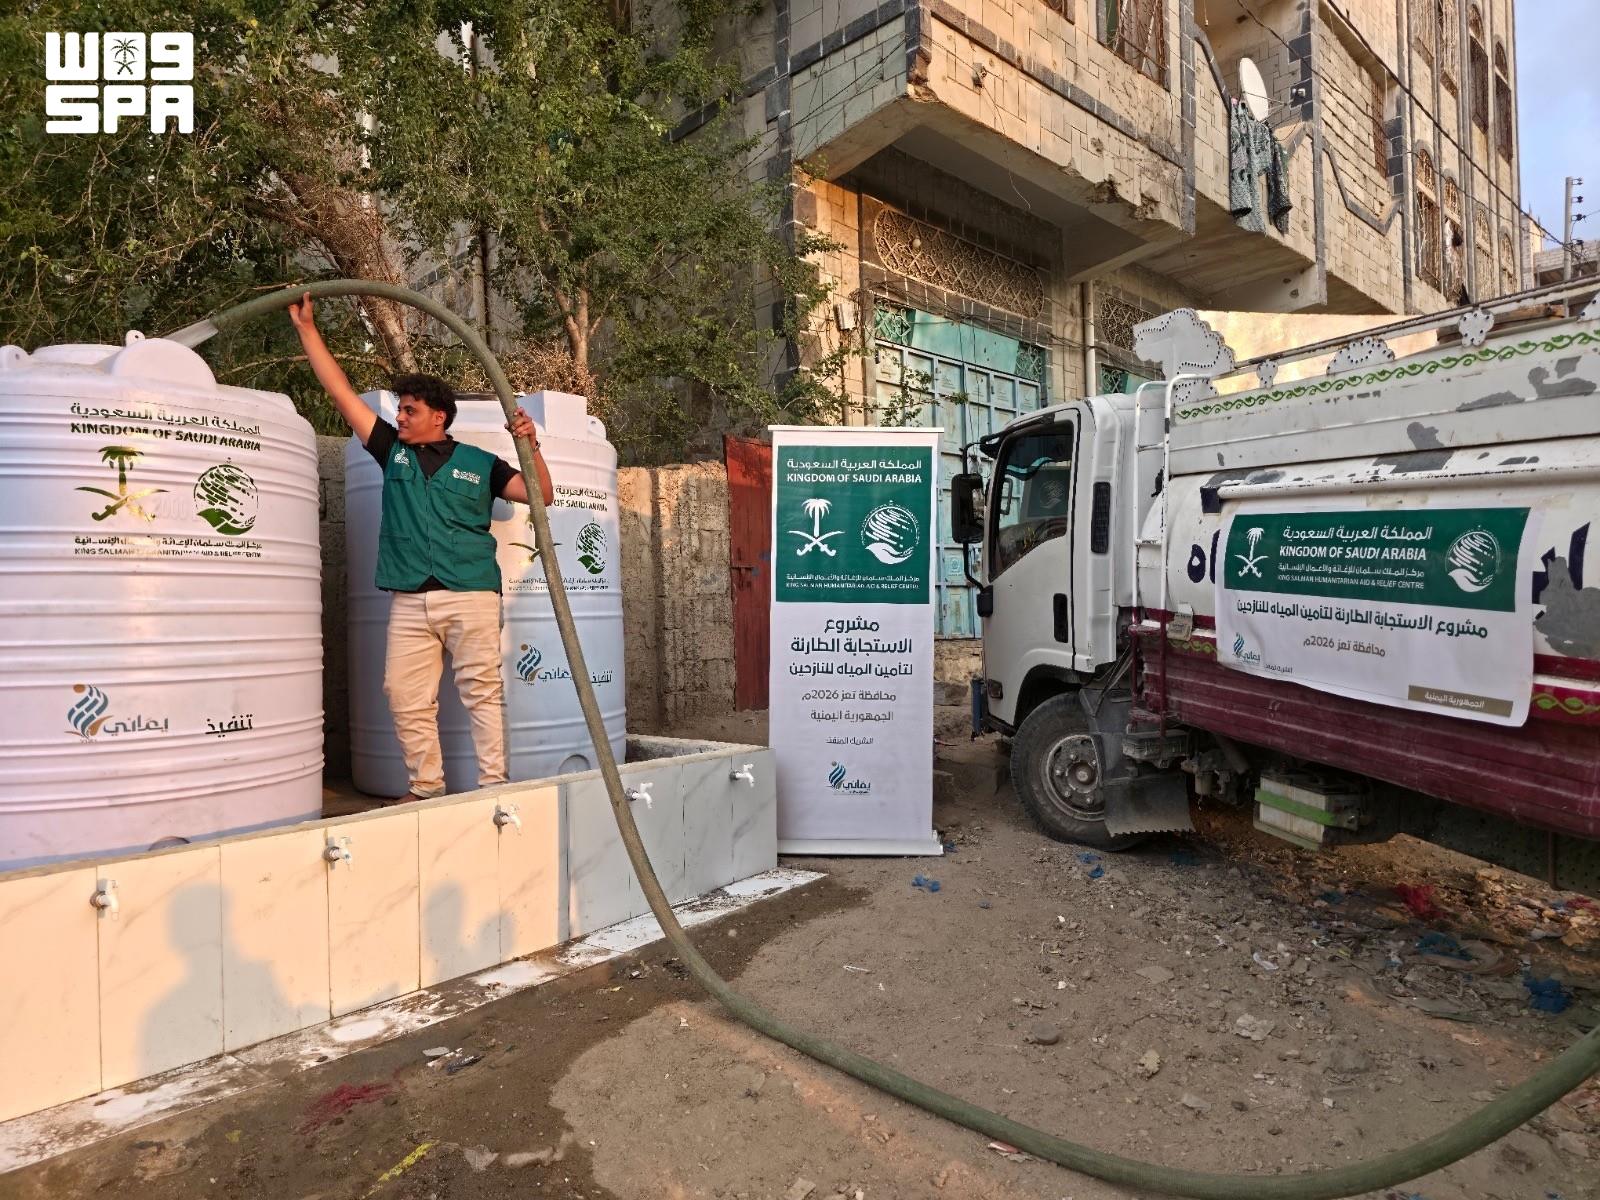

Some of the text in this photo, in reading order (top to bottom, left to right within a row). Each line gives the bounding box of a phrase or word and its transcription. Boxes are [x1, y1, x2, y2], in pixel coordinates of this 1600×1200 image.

[70, 402, 261, 435] المملكة العربية السعودية
[153, 428, 172, 440] OF
[175, 430, 218, 444] SAUDI
[220, 438, 262, 452] ARABIA
[786, 458, 922, 472] المملكة العربية السعودية
[786, 473, 922, 483] KINGDOM OF SAUDI ARABIA
[553, 499, 565, 508] OF
[1282, 524, 1433, 543] المملكة العربية السعودية
[74, 547, 97, 555] KING
[1279, 545, 1427, 561] KINGDOM OF SAUDI ARABIA
[1405, 567, 1425, 578] مركز
[1315, 576, 1359, 585] HUMANITARIAN
[1360, 578, 1370, 586] AID
[1397, 580, 1425, 589] CENTRE
[824, 615, 880, 634] مشروع
[1236, 599, 1488, 638] مشروع الاستجابة الطارئة لتأمين المياه للنازحين
[790, 636, 912, 656] الاستجابة الطارئة
[1336, 639, 1351, 652] تعز
[1352, 640, 1386, 657] محافظة
[789, 662, 913, 678] لتأمين المياه للنازحين
[801, 689, 897, 702] محافظة تعز 2026م
[1448, 695, 1485, 709] الجمهورية
[810, 709, 894, 723] الجمهورية اليمنية
[205, 714, 253, 738] تنفيذ
